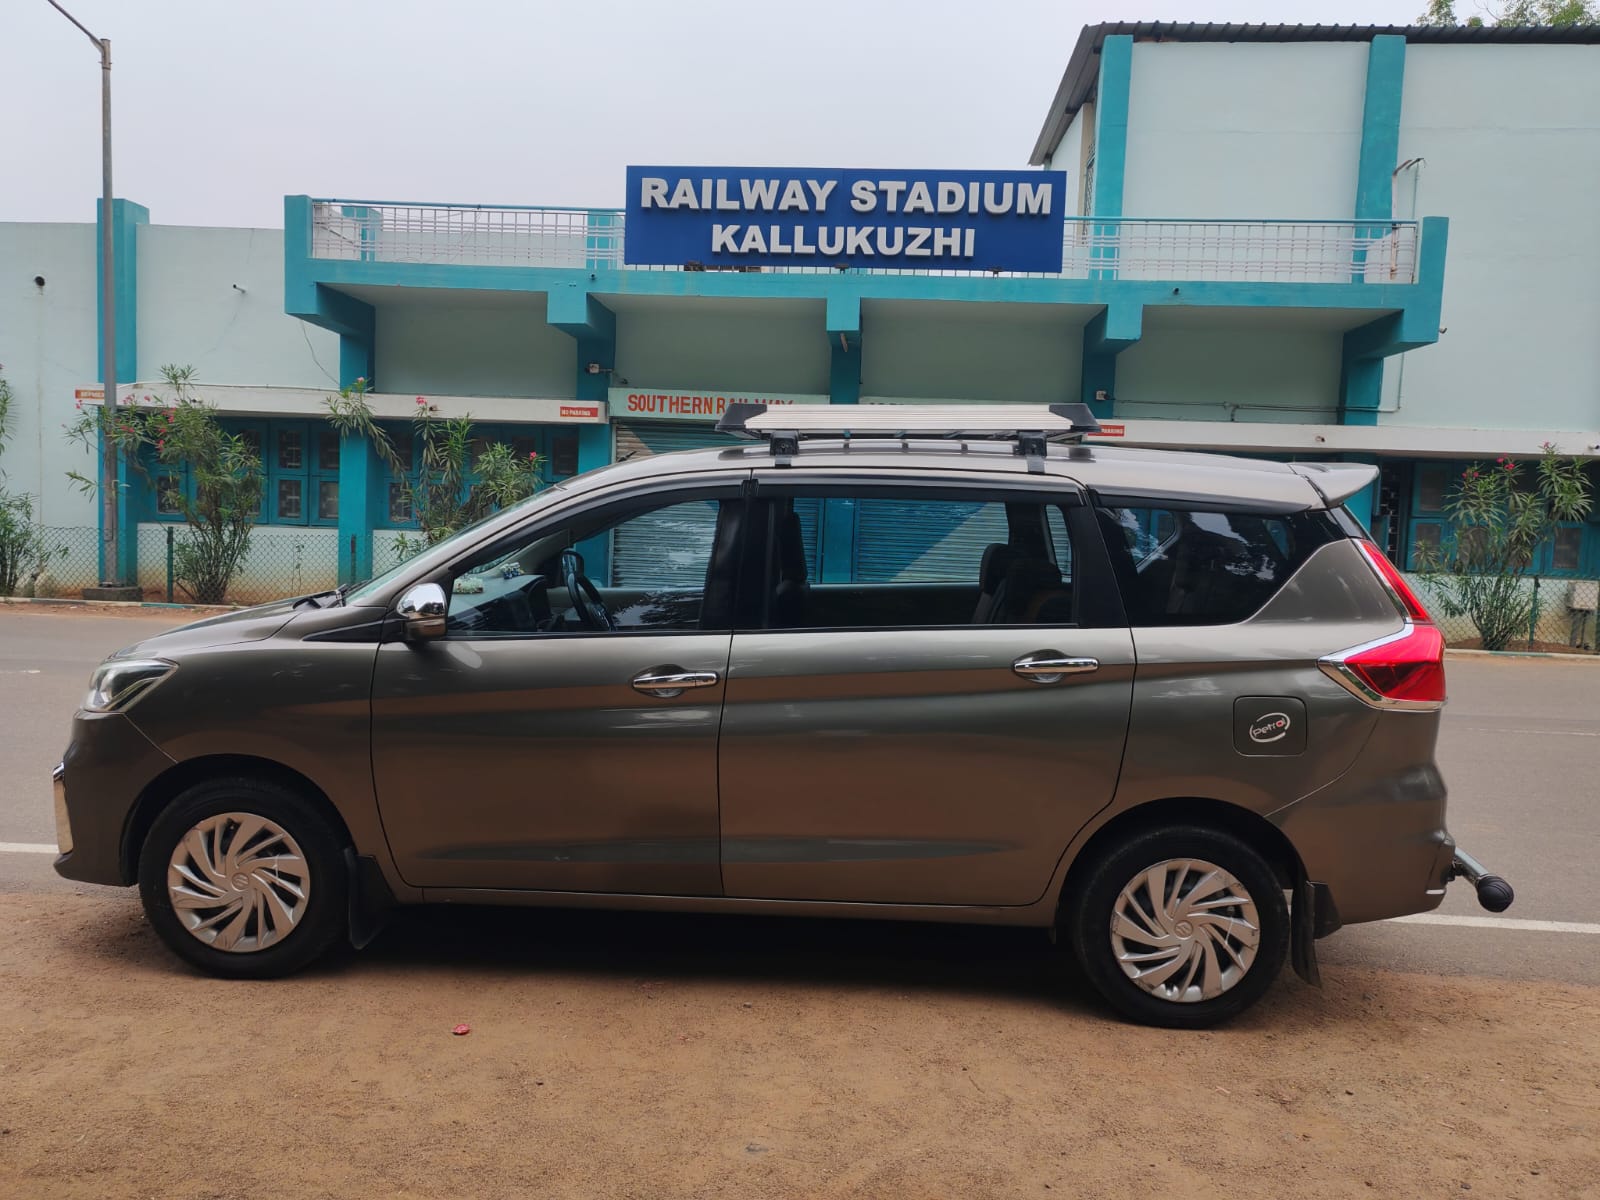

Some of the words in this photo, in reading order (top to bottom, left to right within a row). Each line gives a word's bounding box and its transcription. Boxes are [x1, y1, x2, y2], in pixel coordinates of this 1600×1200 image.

[640, 177, 838, 211] RAILWAY
[850, 179, 1053, 215] STADIUM
[711, 224, 976, 257] KALLUKUZHI
[627, 394, 713, 415] SOUTHERN
